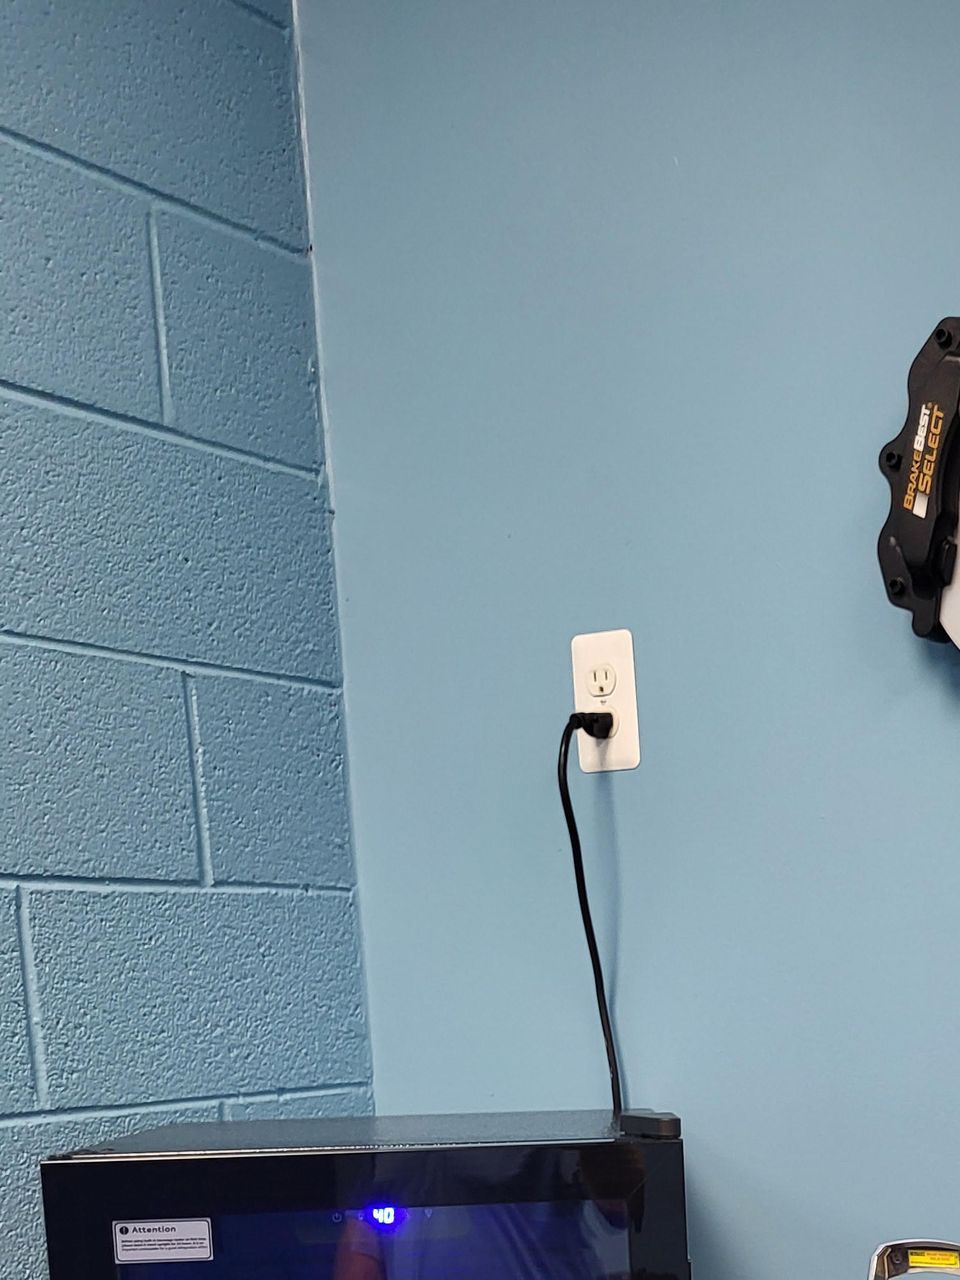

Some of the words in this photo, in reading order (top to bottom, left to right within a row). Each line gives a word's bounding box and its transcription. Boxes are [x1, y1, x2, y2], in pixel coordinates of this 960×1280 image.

[918, 404, 945, 496] SELECT
[373, 1207, 394, 1224] 40
[132, 1225, 176, 1234] Attention
